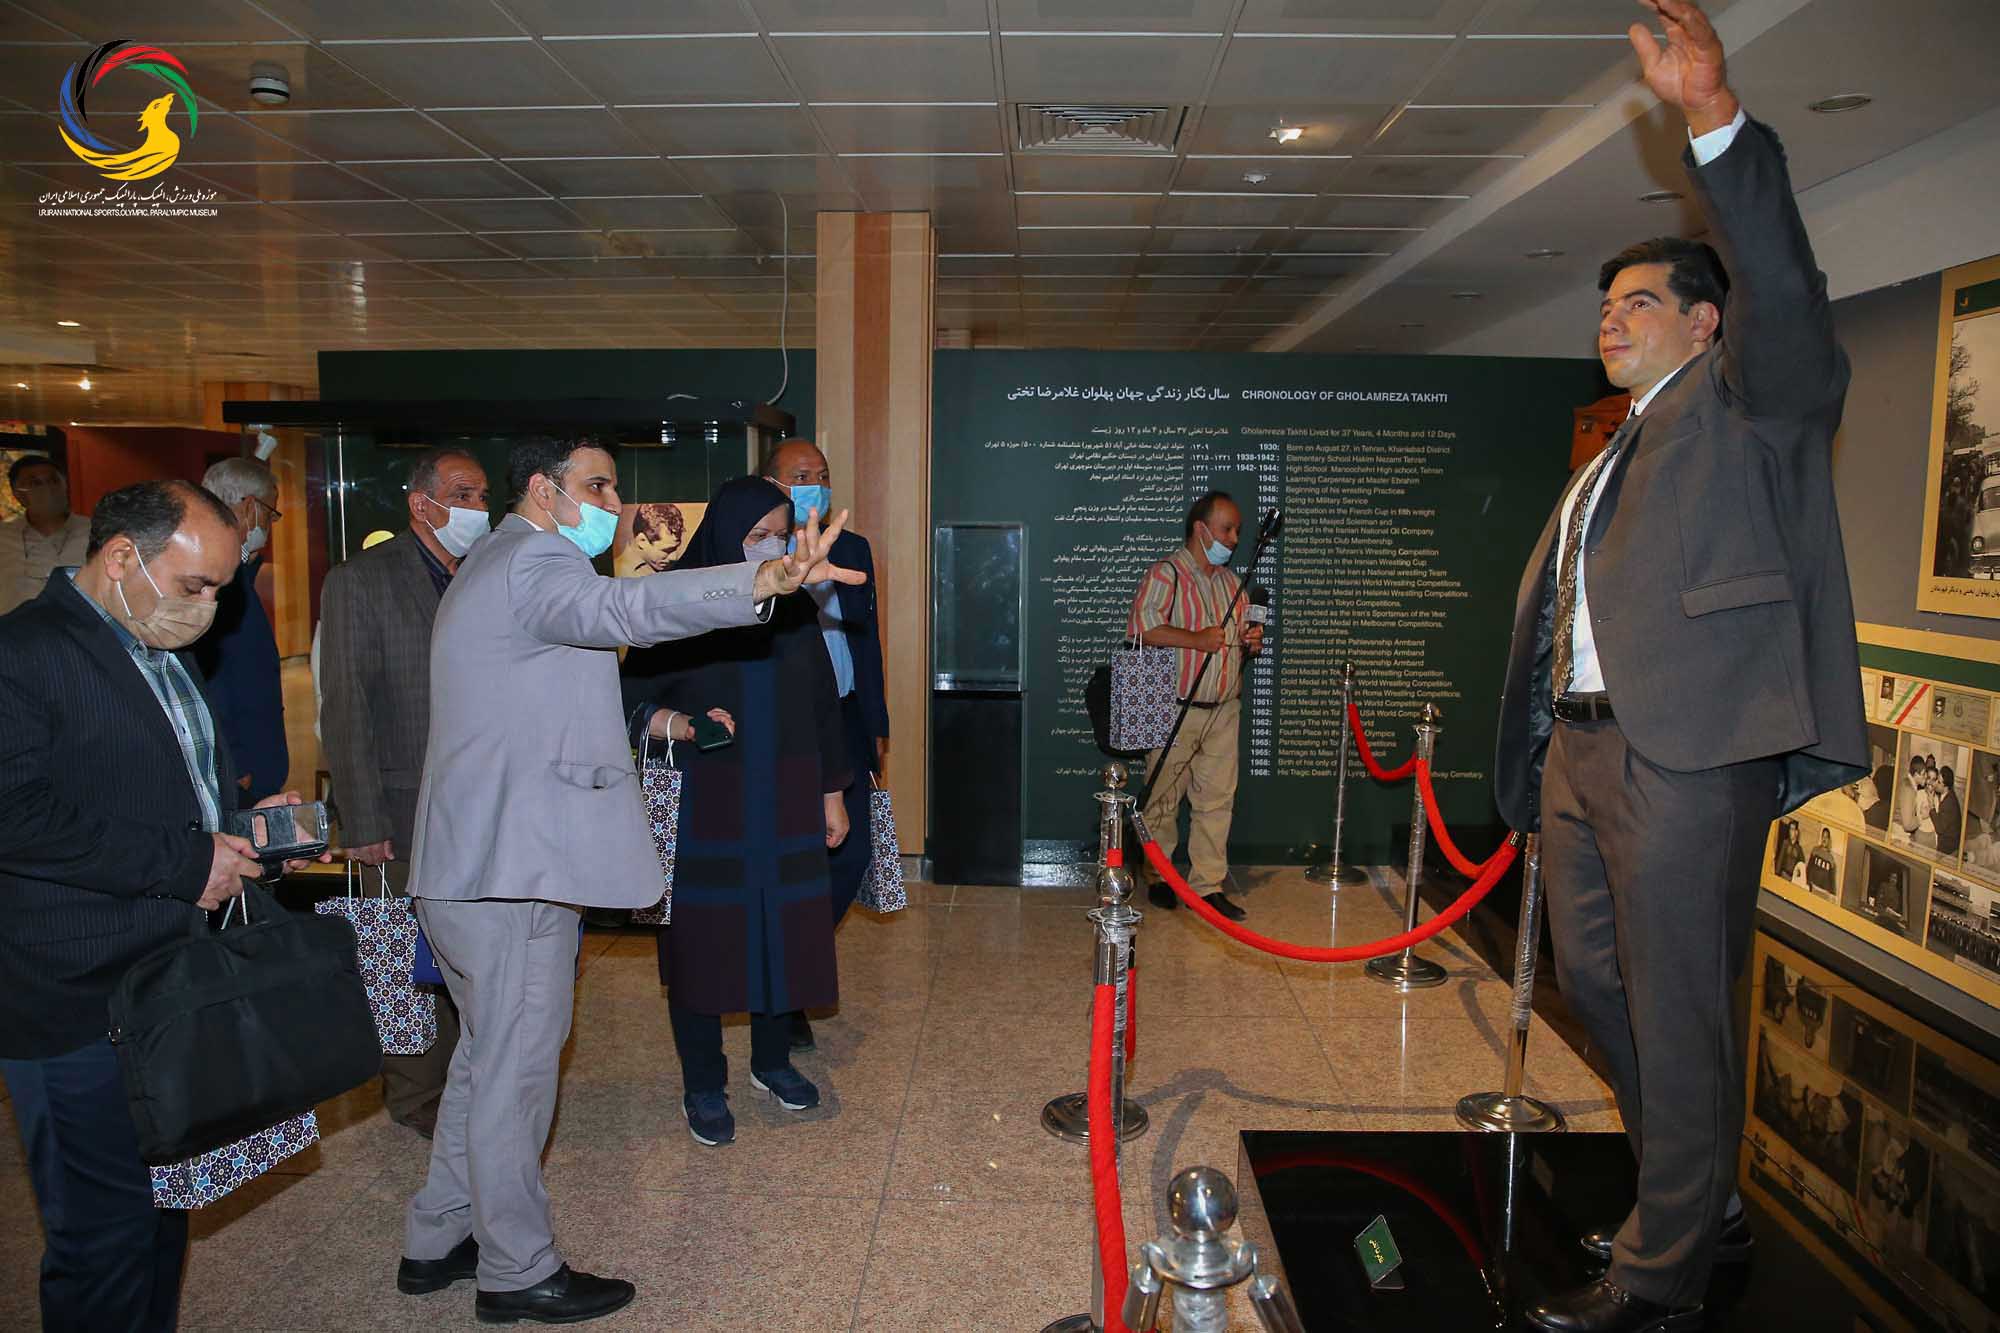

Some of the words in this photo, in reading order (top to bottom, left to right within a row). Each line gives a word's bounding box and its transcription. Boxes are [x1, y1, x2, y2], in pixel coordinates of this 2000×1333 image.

[1007, 388, 1034, 401] تختی
[1037, 386, 1079, 400] غلامرضا
[1082, 386, 1114, 402] پهلوان
[1116, 386, 1145, 401] جهان
[1146, 386, 1182, 402] زندگی
[1186, 386, 1206, 402] نگار
[1208, 387, 1230, 400] سال
[1242, 390, 1317, 400] CHRONOLOGY
[1319, 391, 1334, 400] OF
[1336, 392, 1410, 402] GHOLAMREZA
[1411, 392, 1448, 403] TAKHTI
